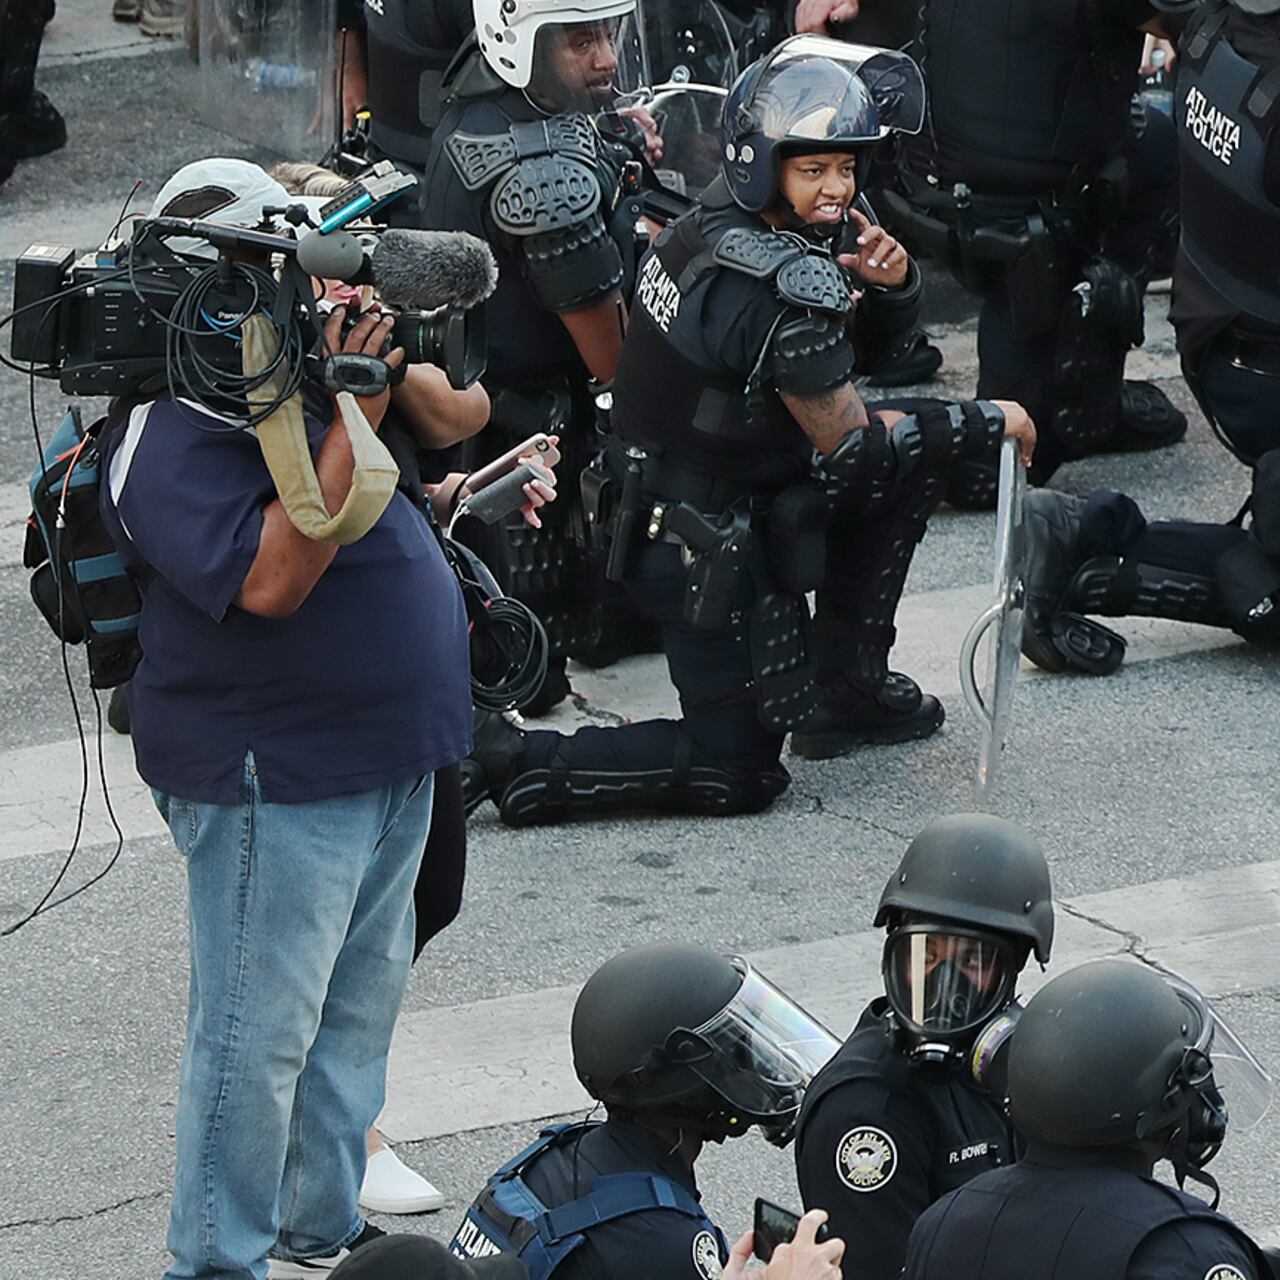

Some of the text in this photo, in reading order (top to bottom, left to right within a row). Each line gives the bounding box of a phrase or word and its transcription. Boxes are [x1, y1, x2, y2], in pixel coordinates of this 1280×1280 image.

[1185, 85, 1240, 150] ATLANTA
[1185, 106, 1231, 166] POLICE
[637, 275, 670, 333] POLICE
[641, 253, 681, 318] ATLANTA
